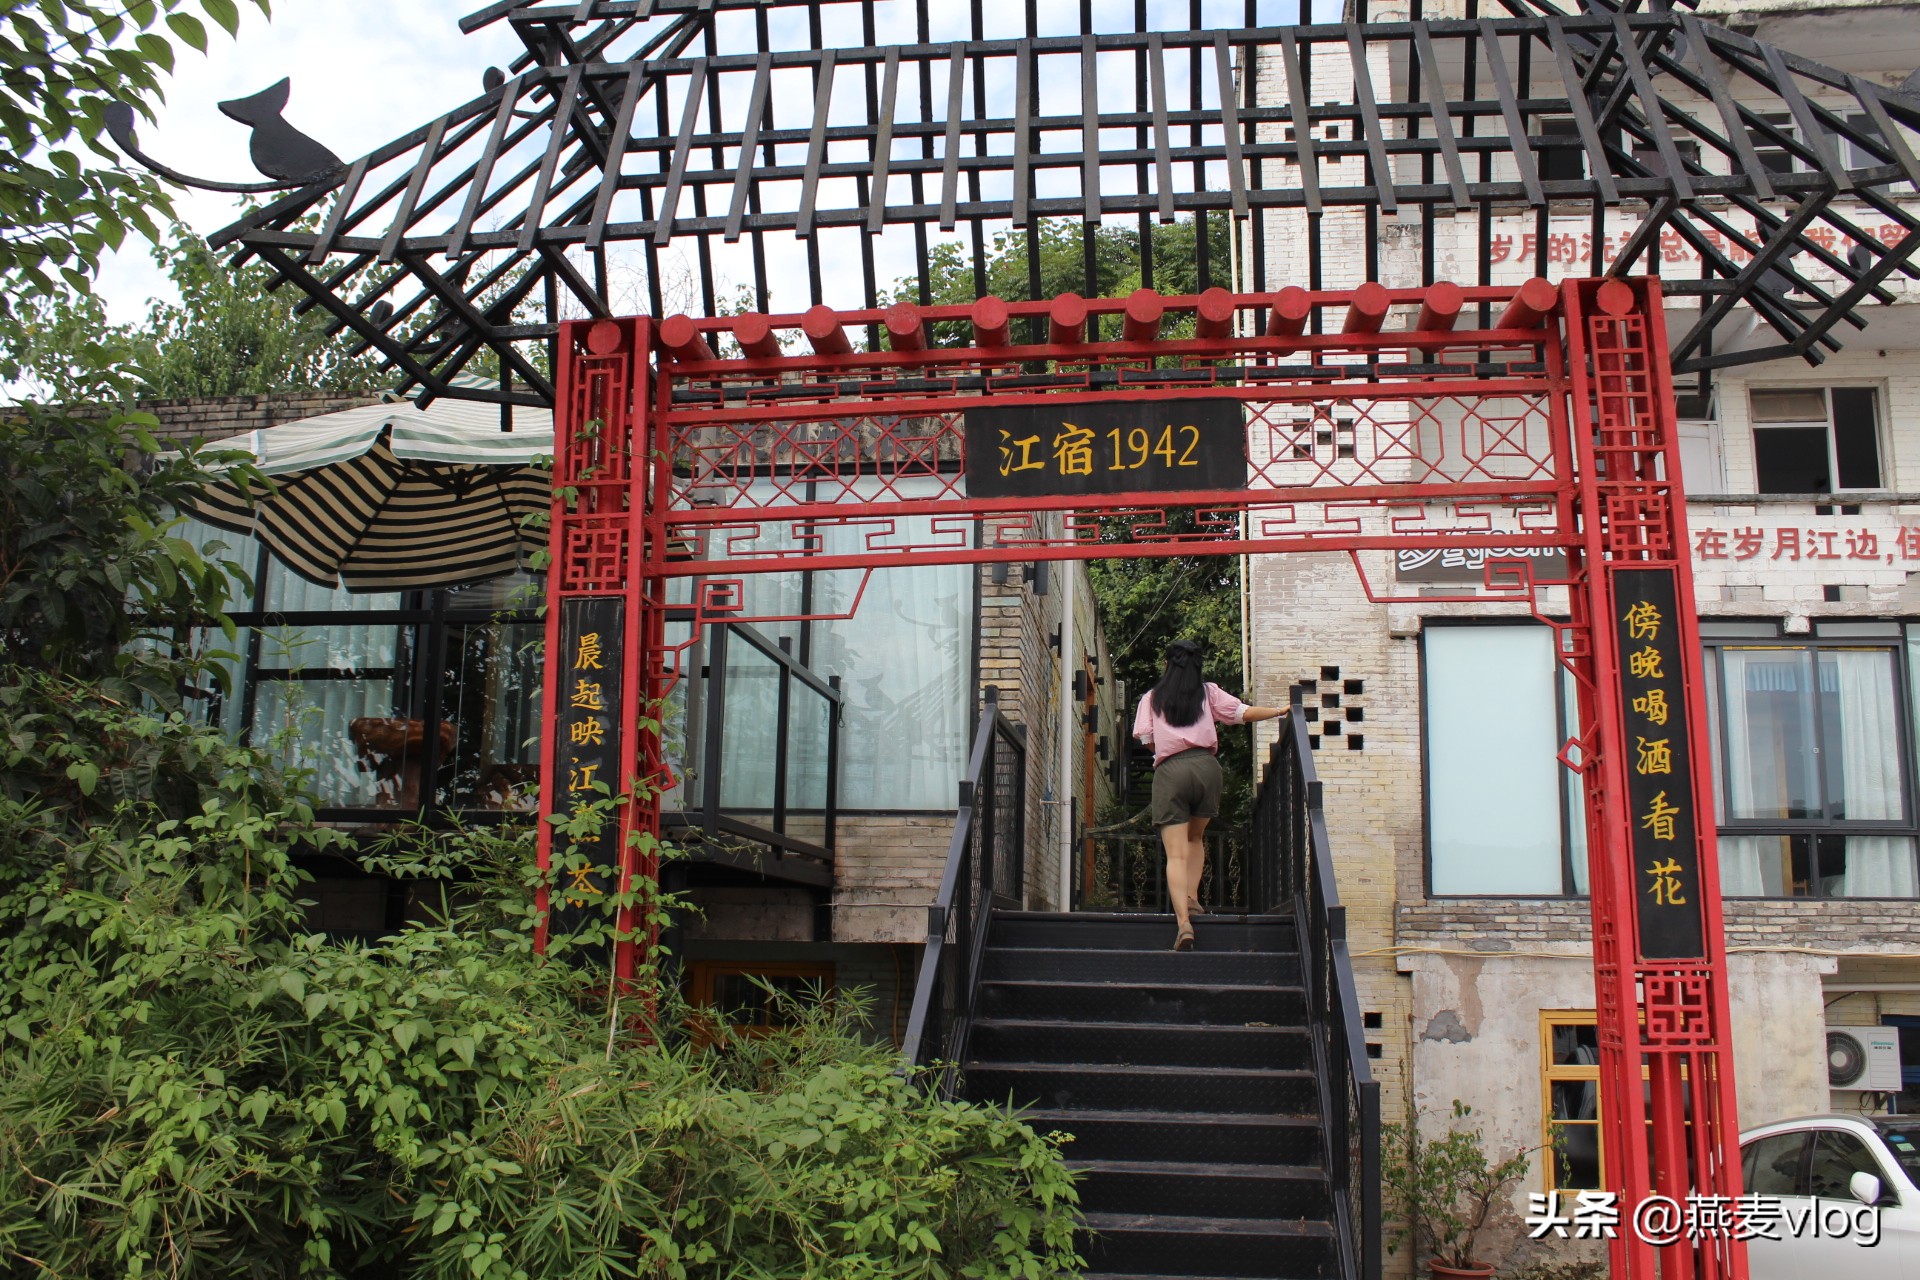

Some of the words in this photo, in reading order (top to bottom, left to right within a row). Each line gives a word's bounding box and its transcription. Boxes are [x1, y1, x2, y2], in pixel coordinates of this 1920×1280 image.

[998, 421, 1200, 477] 江宿1942
[567, 632, 604, 908] 晨起映江茶
[1623, 600, 1686, 905] 傍晚喝酒看花
